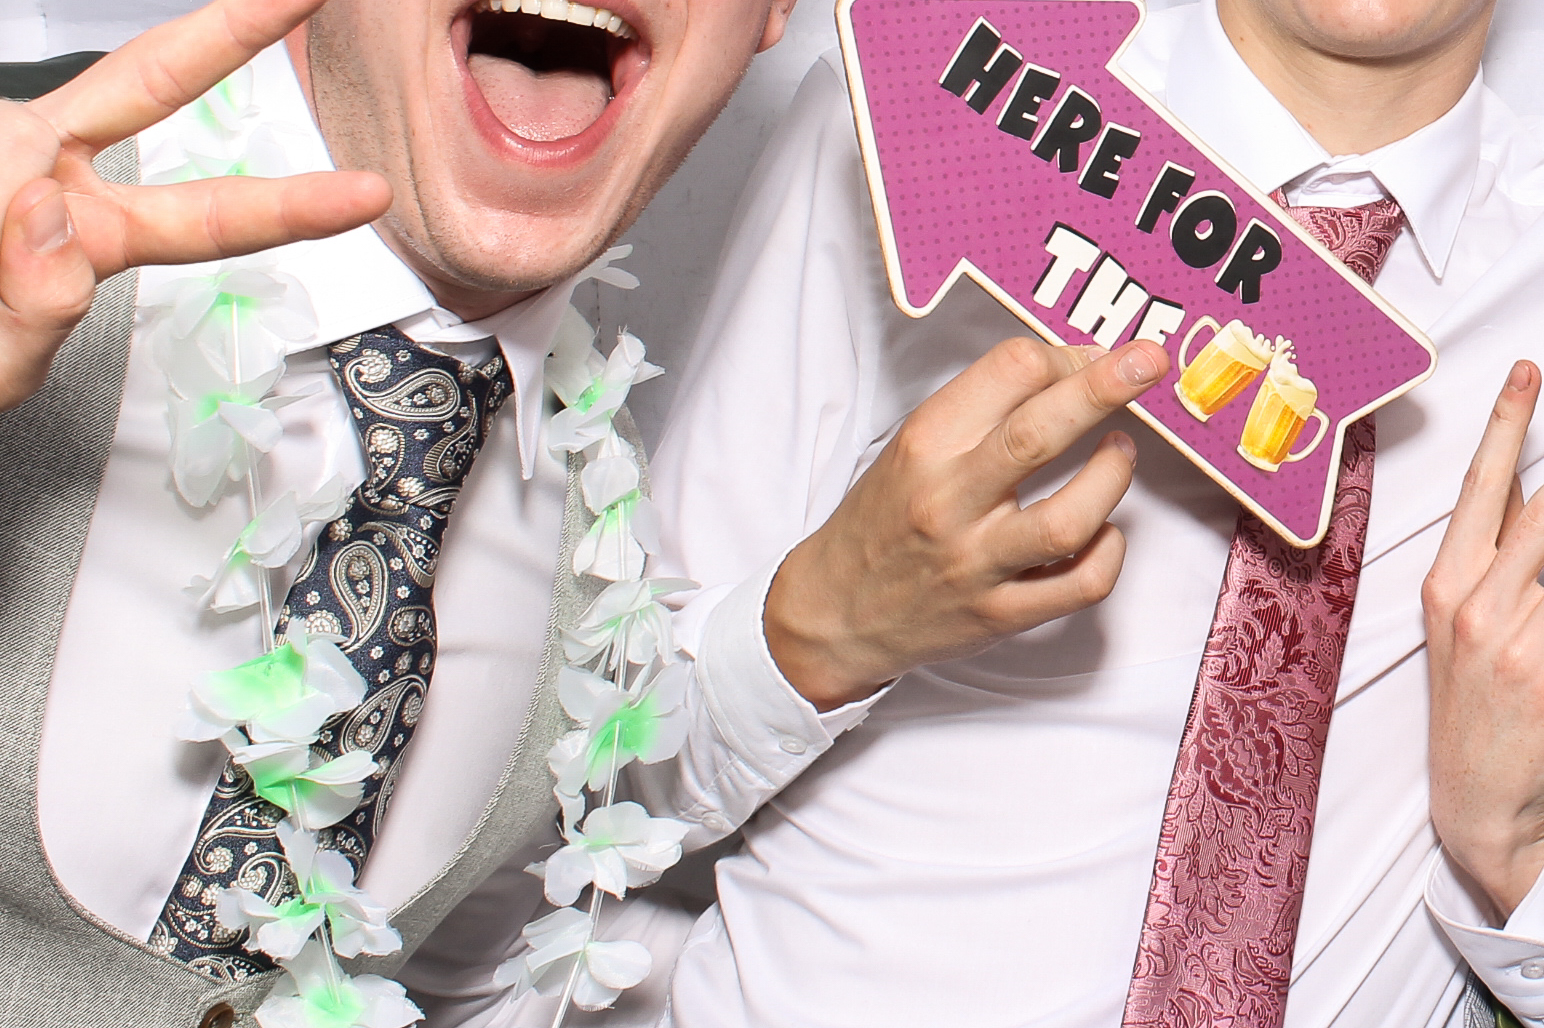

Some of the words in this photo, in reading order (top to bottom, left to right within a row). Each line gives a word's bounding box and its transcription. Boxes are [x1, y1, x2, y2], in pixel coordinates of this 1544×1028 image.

[938, 16, 1141, 200] HERE
[1135, 160, 1283, 304] FOR
[1032, 221, 1187, 351] THE
